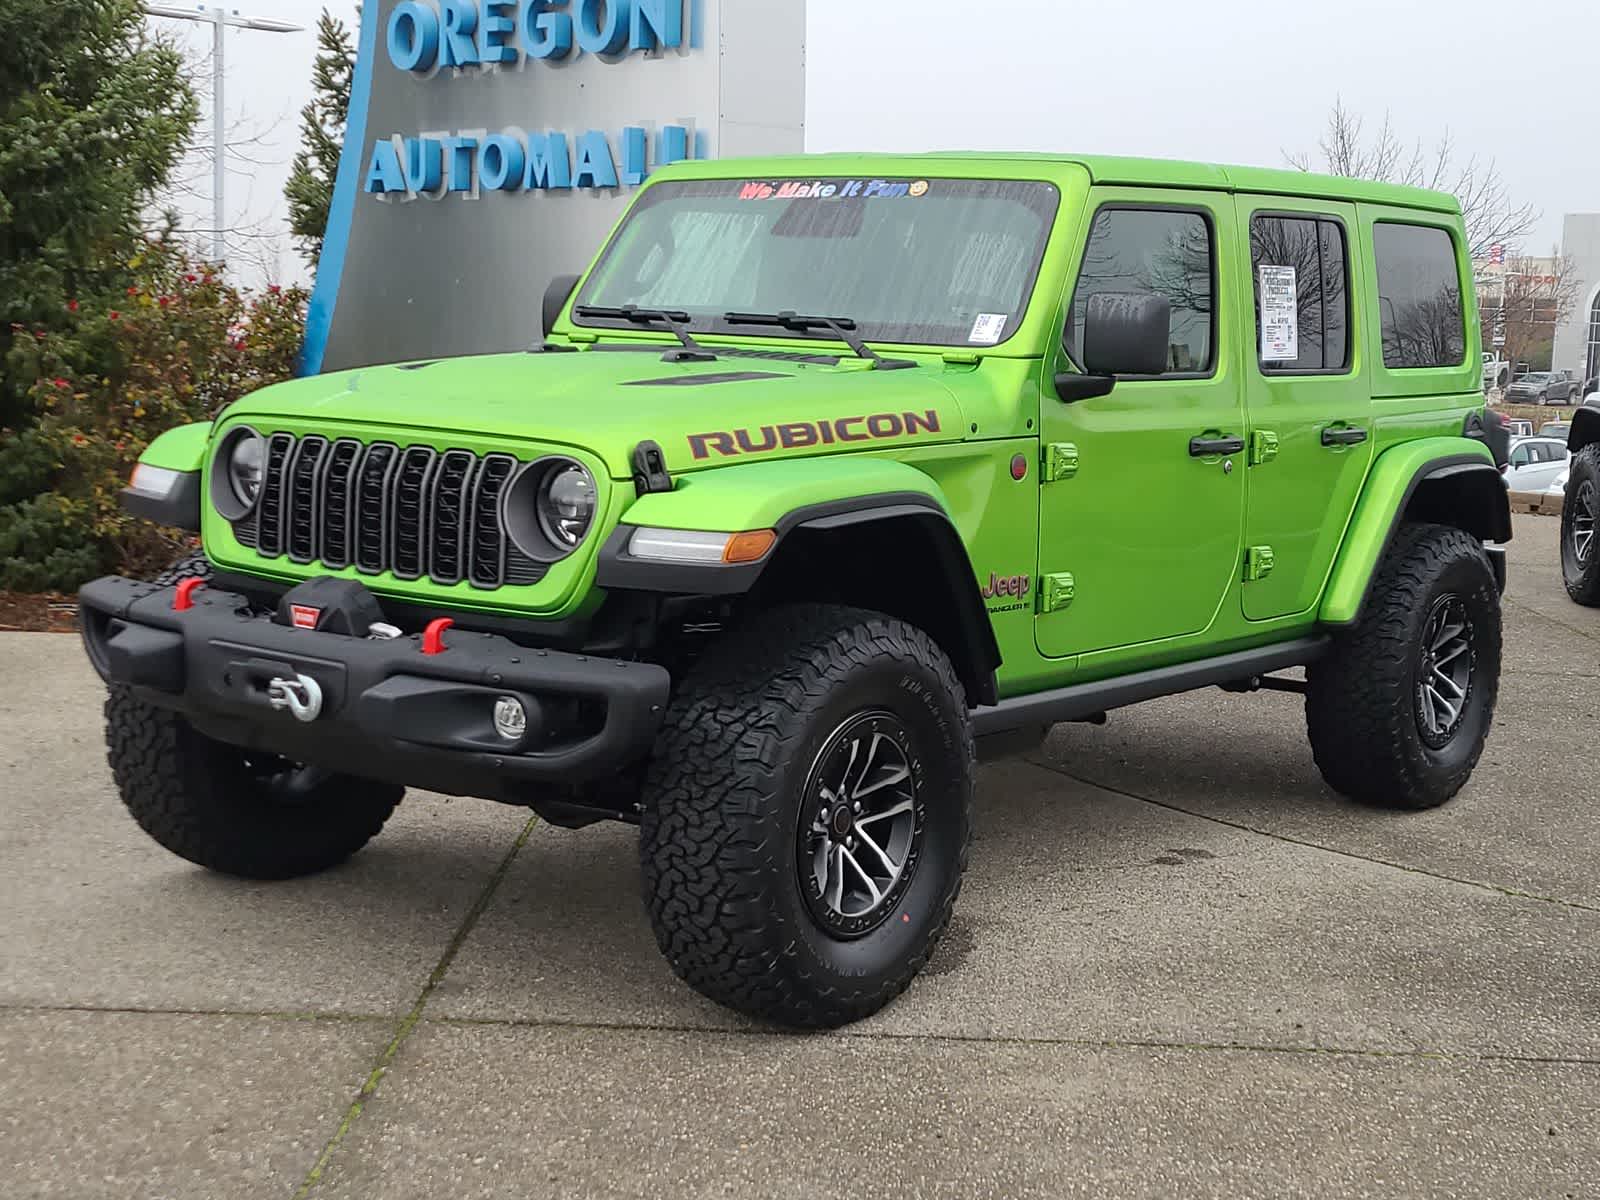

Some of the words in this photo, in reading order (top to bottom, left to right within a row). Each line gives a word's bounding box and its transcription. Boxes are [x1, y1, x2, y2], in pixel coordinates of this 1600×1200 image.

[387, 0, 683, 72] OREGON
[738, 181, 773, 200] We
[774, 180, 837, 199] Make
[839, 180, 863, 198] It
[862, 179, 909, 198] Fun
[687, 409, 941, 460] RUBICON
[981, 571, 1030, 600] Jeep
[985, 603, 1024, 614] RANGLER
